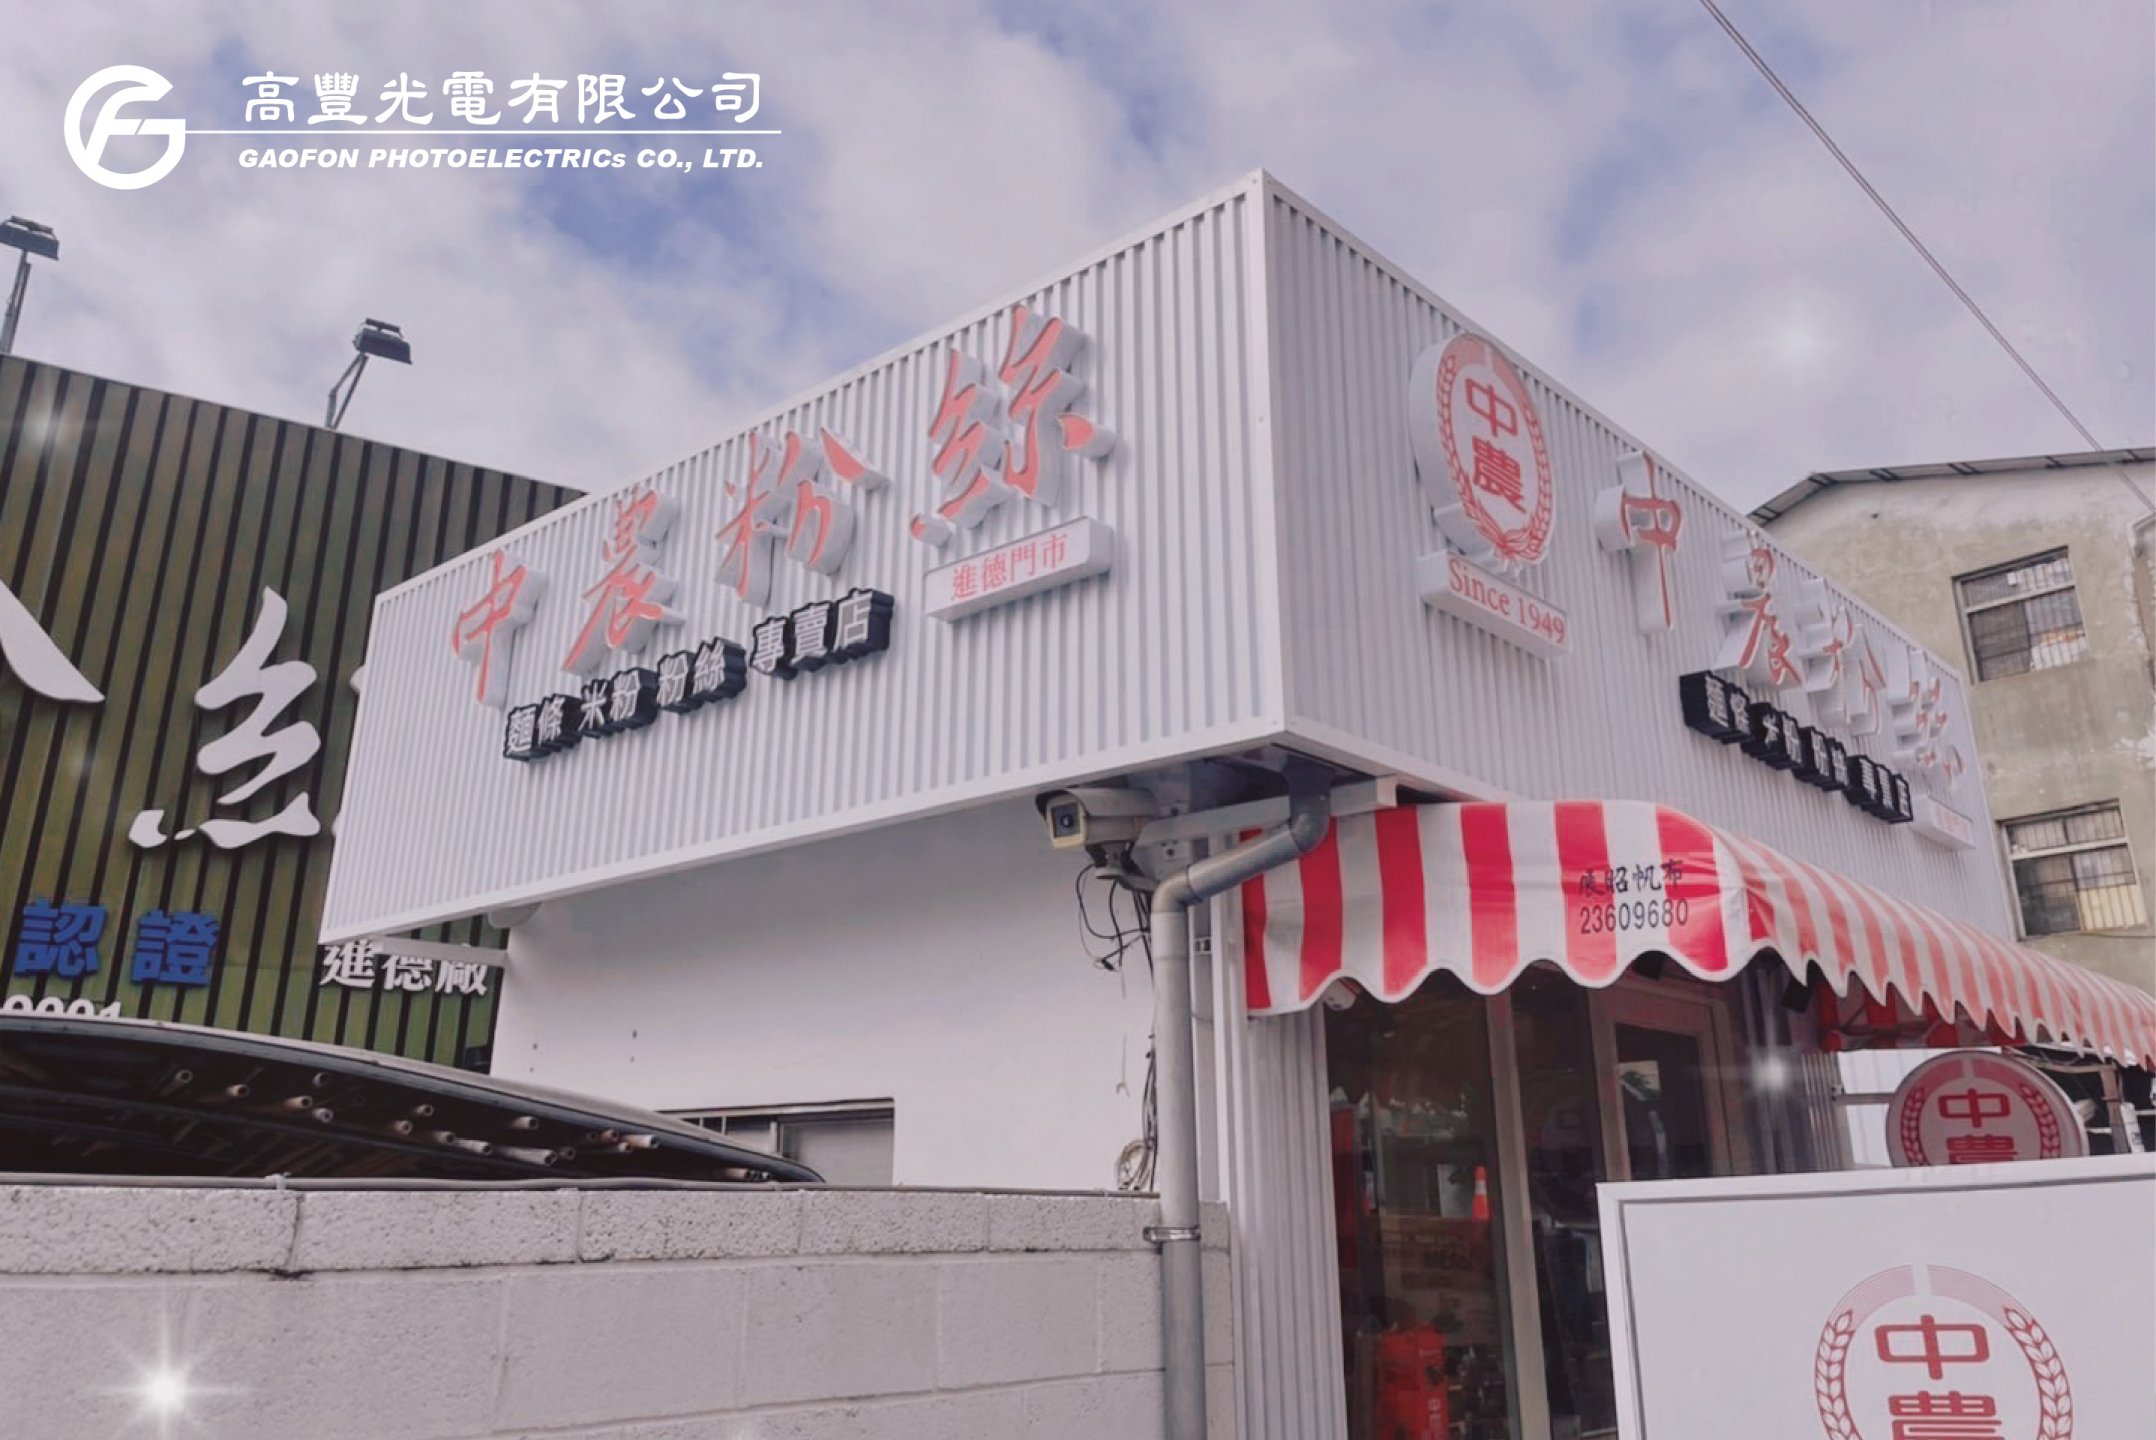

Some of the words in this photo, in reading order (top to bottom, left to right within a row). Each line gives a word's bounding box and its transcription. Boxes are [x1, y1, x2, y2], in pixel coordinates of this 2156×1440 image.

[1464, 377, 1527, 514] 中農
[952, 533, 1068, 602] 進德門市
[1450, 557, 1512, 617] Since
[1517, 596, 1566, 645] 1949
[578, 669, 641, 732] 米粉
[656, 641, 726, 707] 粉絲
[753, 588, 873, 674] 專賣店
[13, 899, 221, 987] 認證
[1579, 898, 1689, 934] 23609680
